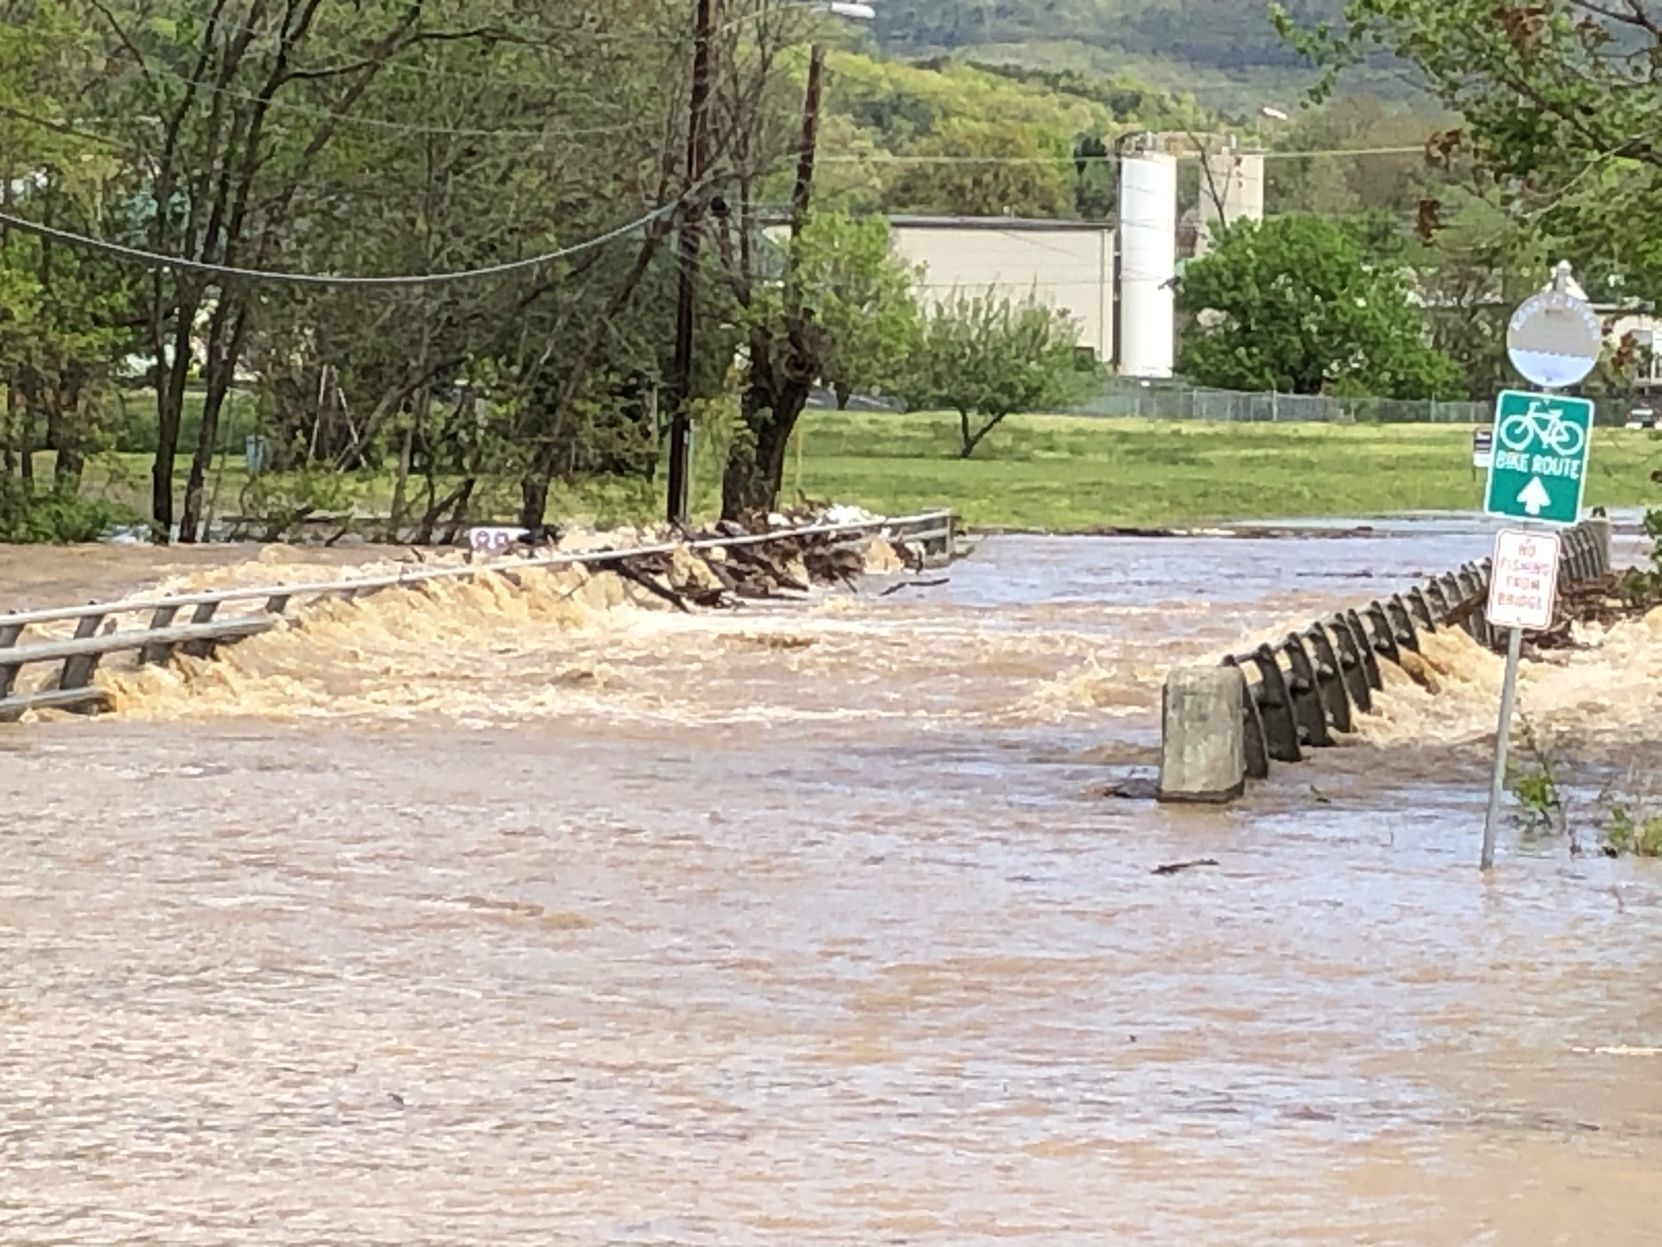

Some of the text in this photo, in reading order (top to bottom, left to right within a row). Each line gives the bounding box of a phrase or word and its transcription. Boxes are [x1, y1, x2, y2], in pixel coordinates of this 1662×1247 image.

[1496, 449, 1529, 473] BIKE
[1531, 454, 1580, 480] ROUTE
[1518, 543, 1536, 557] NO
[1500, 557, 1550, 576] FISHING
[1506, 575, 1540, 591] FROM
[1498, 592, 1542, 610] BRIDGE
